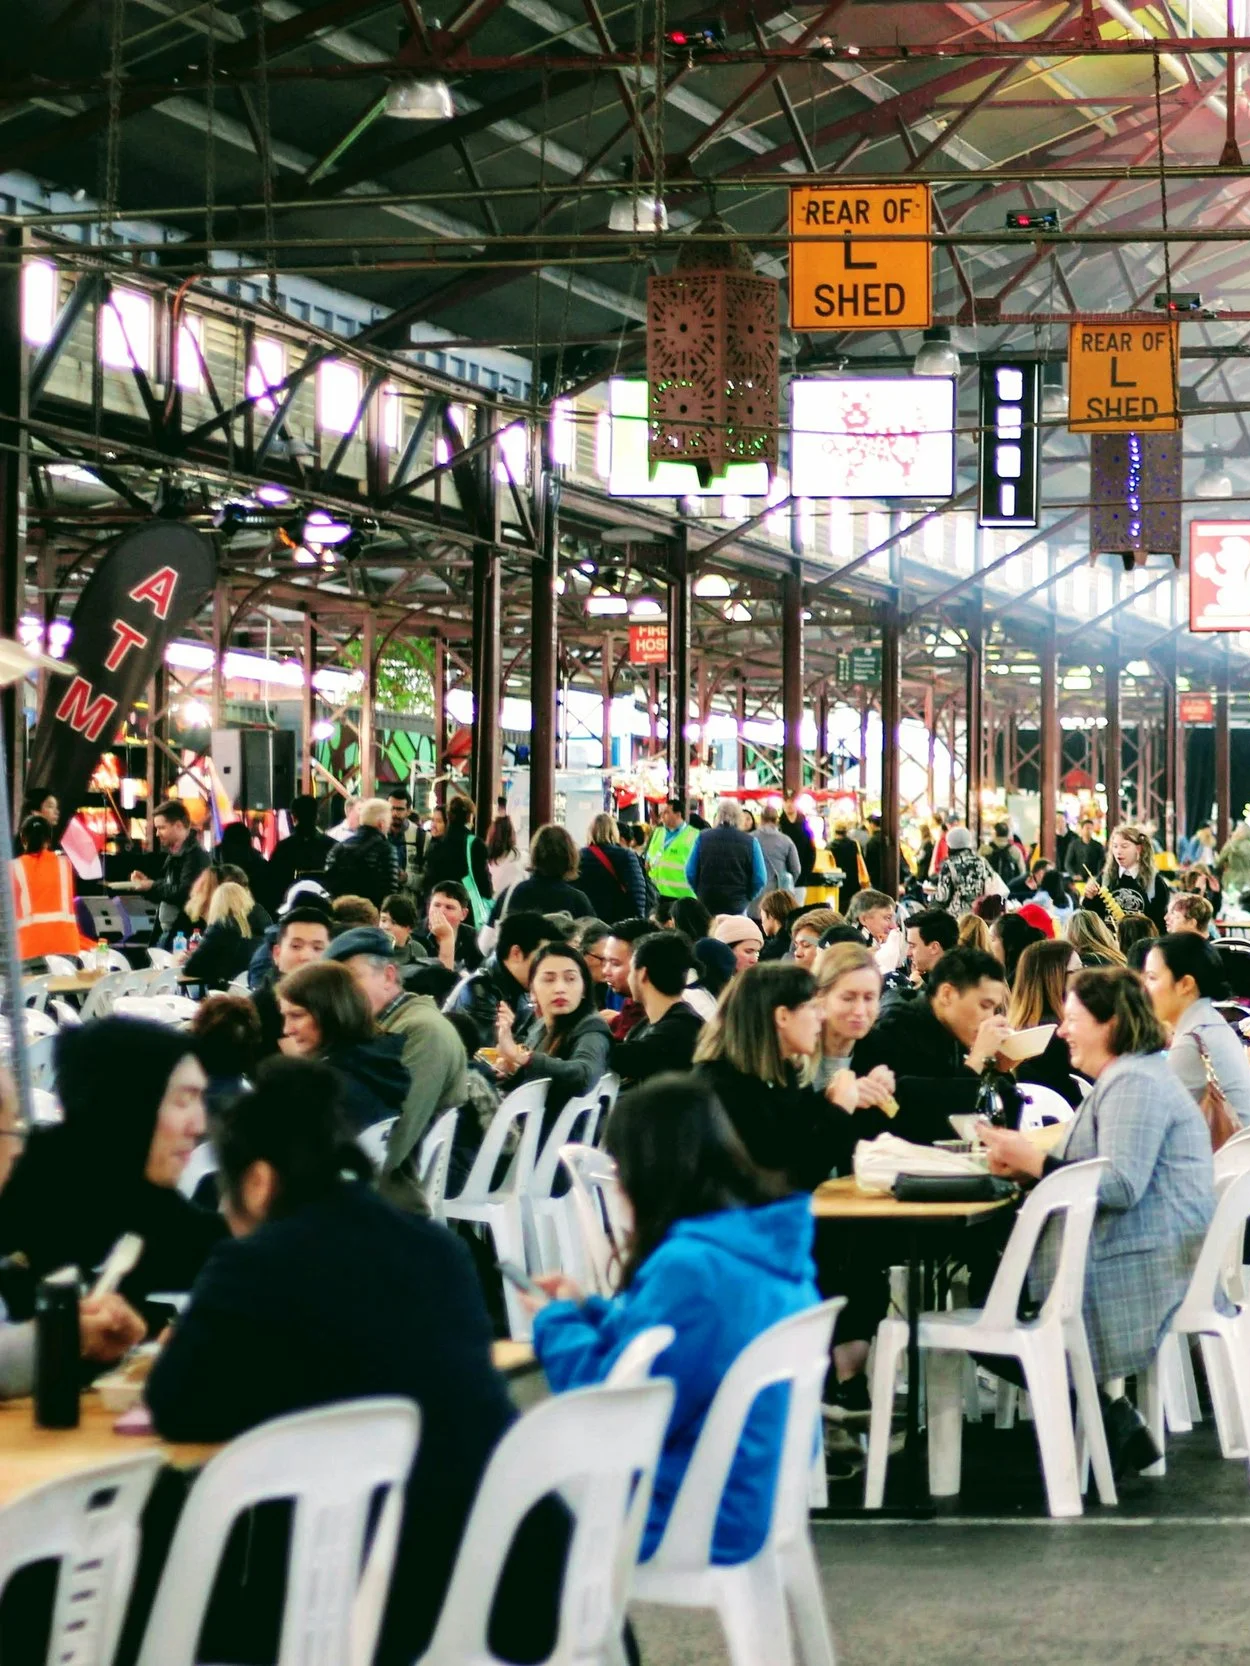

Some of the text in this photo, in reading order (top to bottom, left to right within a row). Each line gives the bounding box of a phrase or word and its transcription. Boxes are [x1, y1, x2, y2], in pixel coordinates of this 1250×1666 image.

[805, 198, 913, 225] REAR OF
[844, 229, 878, 270] L
[814, 282, 906, 317] SHED
[1082, 332, 1166, 352] REAR OF
[1110, 356, 1137, 388] L
[1086, 397, 1159, 422] SHED
[638, 625, 668, 637] FIRE
[56, 566, 178, 742] ATM
[636, 638, 668, 652] HOS
